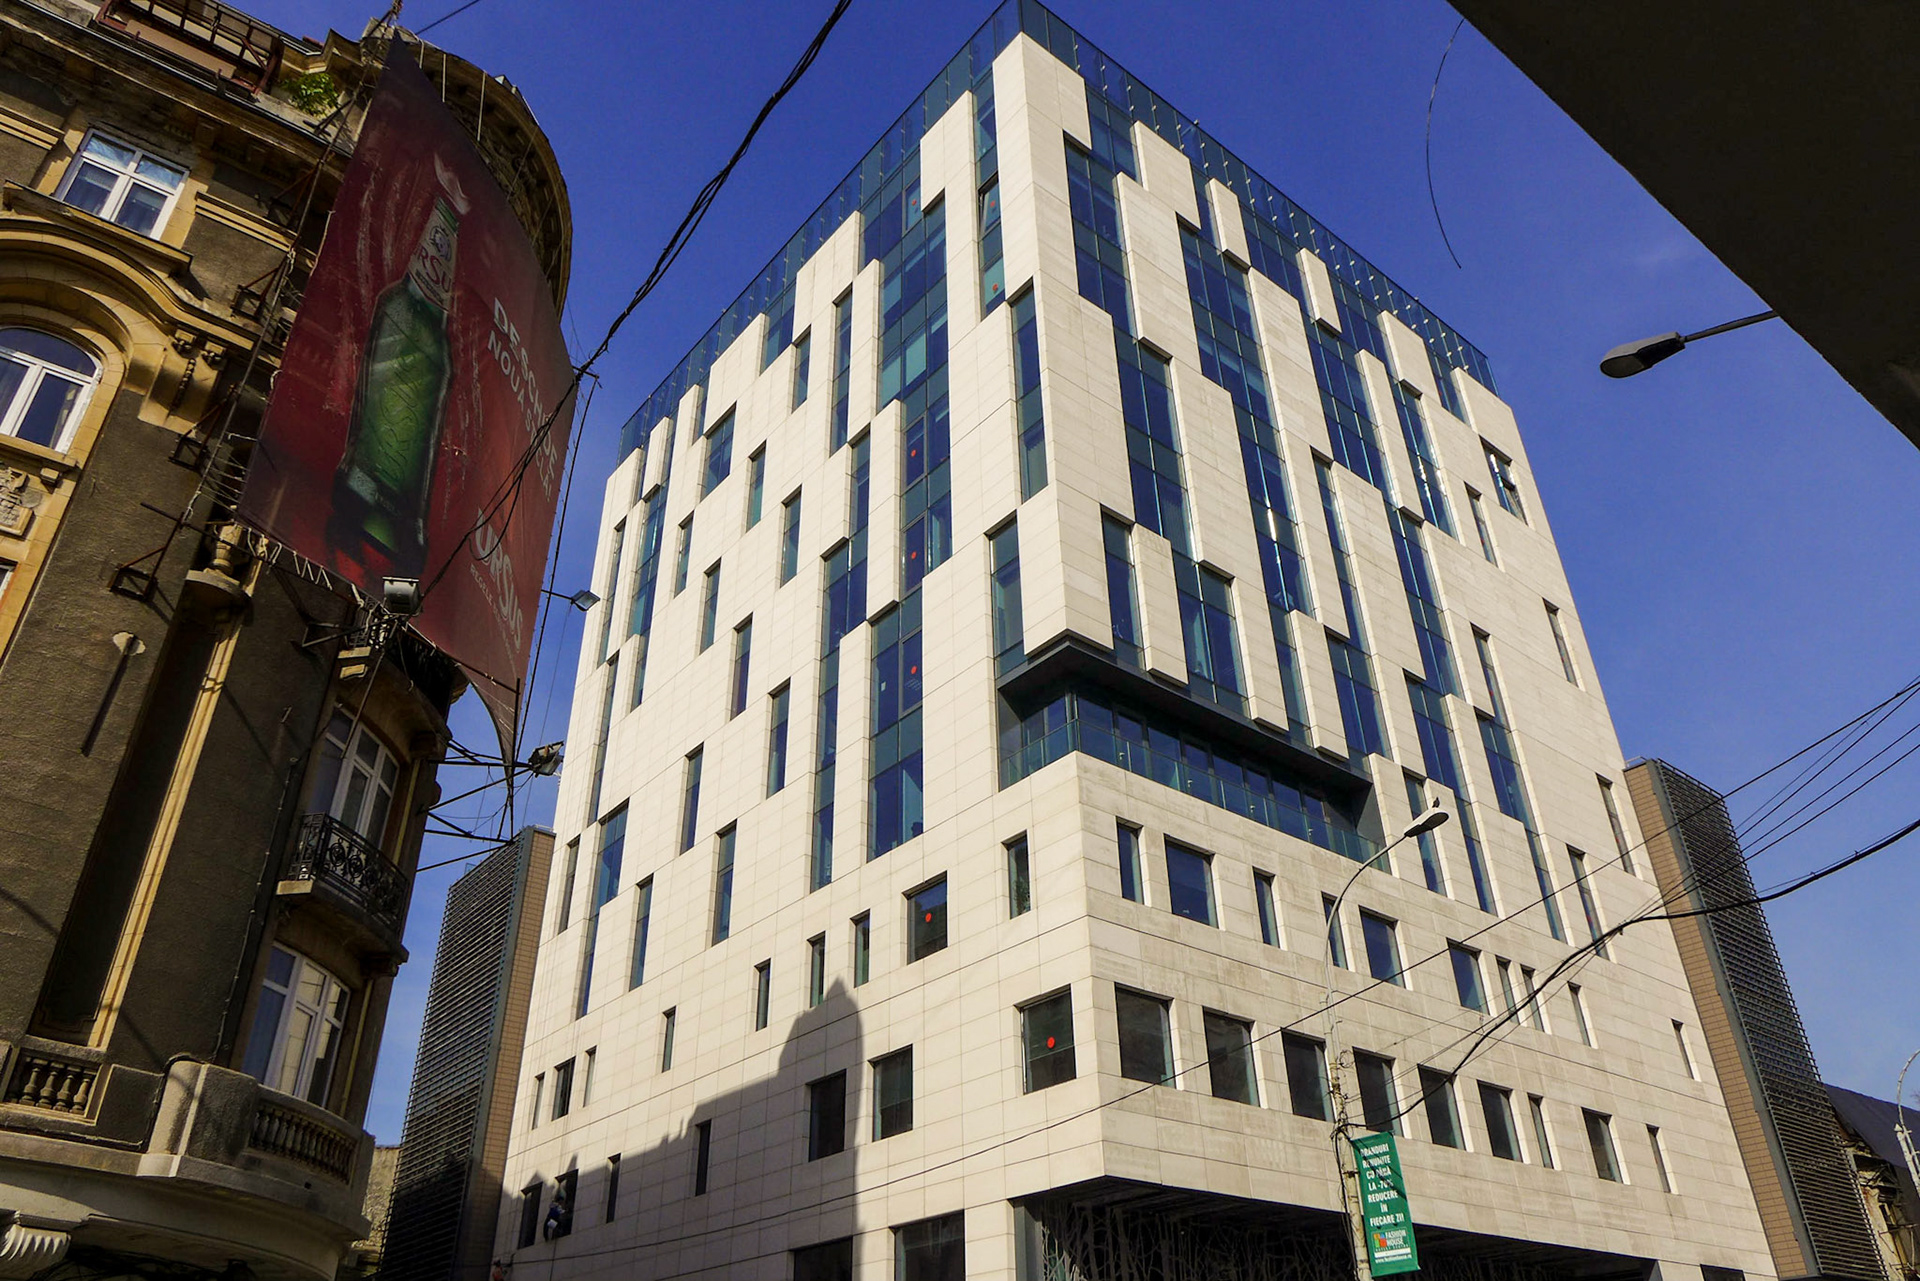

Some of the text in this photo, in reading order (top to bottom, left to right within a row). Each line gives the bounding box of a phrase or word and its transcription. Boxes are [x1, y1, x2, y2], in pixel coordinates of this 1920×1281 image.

[487, 329, 525, 412] NOUA
[475, 507, 523, 653] URSUS
[1368, 1182, 1377, 1191] LA
[1367, 1190, 1399, 1203] REDUCERE
[1369, 1214, 1395, 1227] FIECARE
[1385, 1229, 1407, 1239] FASHION
